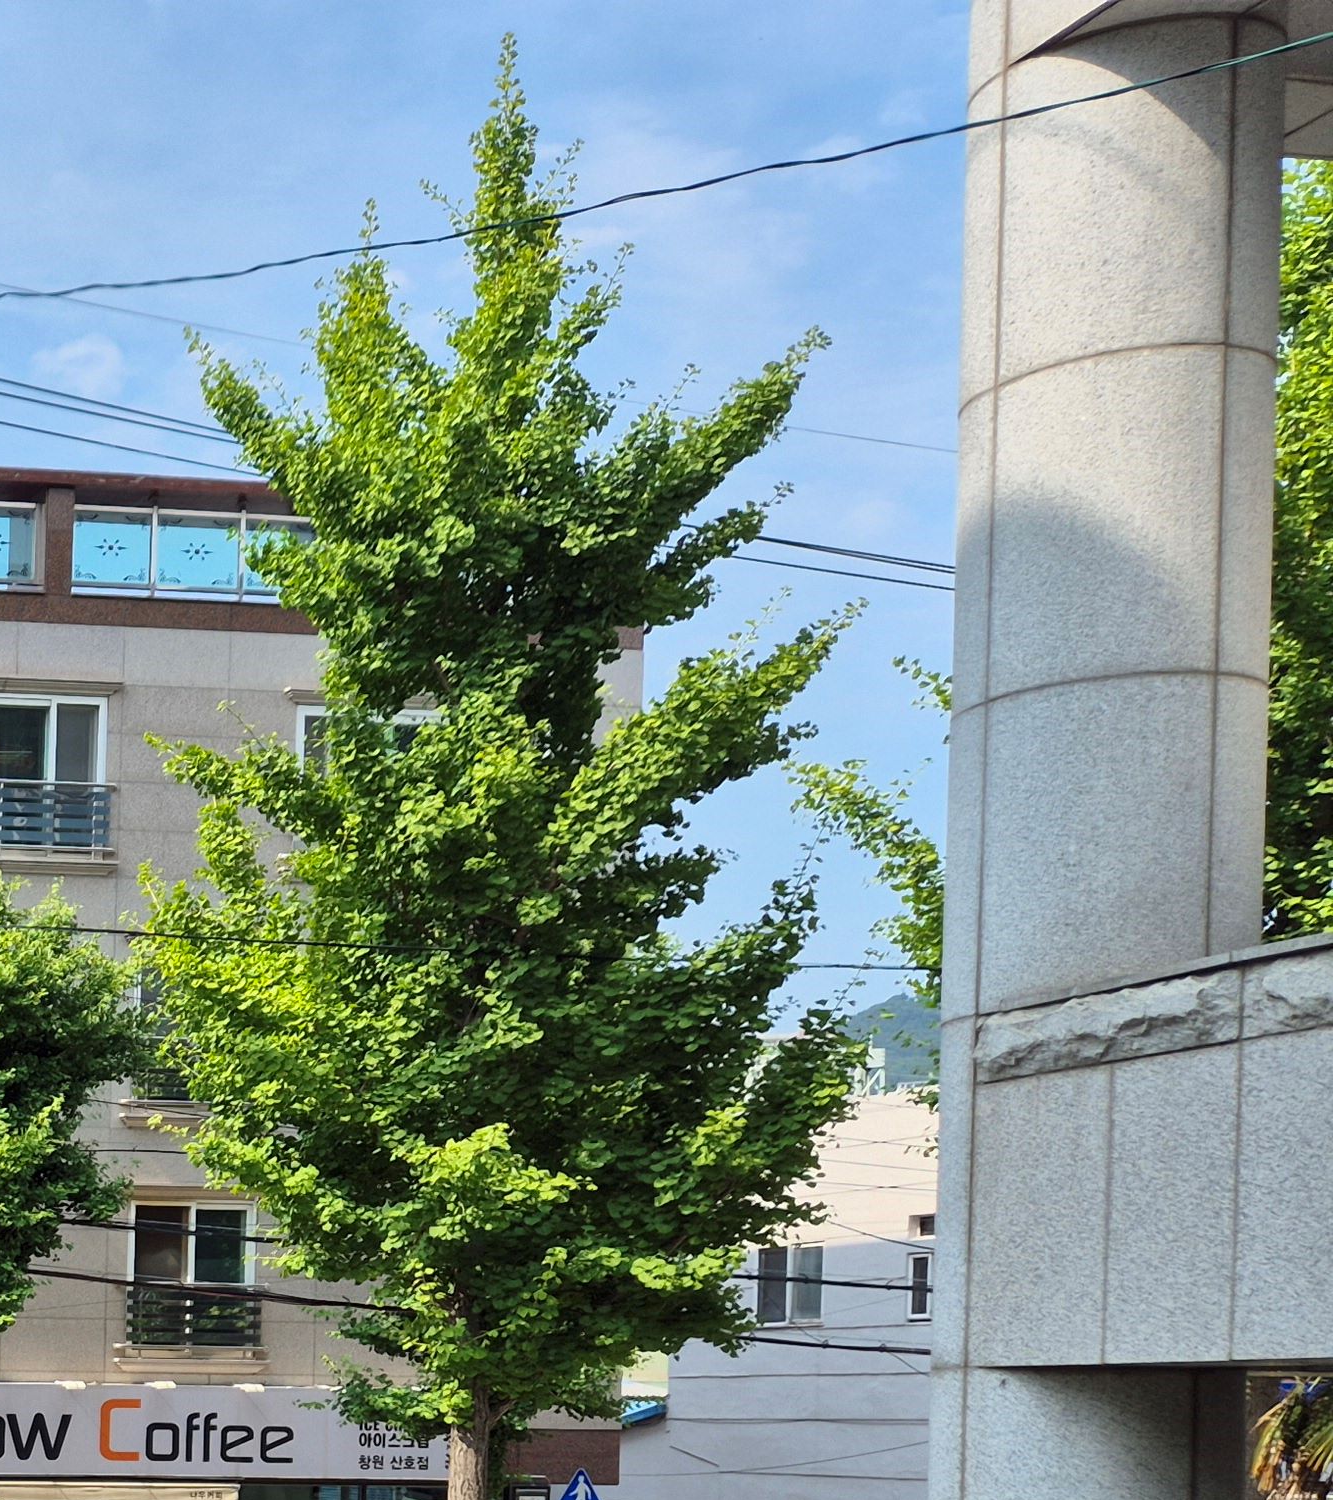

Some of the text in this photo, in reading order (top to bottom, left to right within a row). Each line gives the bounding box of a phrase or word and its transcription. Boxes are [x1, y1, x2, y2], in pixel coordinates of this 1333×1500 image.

[99, 1398, 294, 1464] Coffee
[358, 1455, 429, 1471] 창원 산호점
